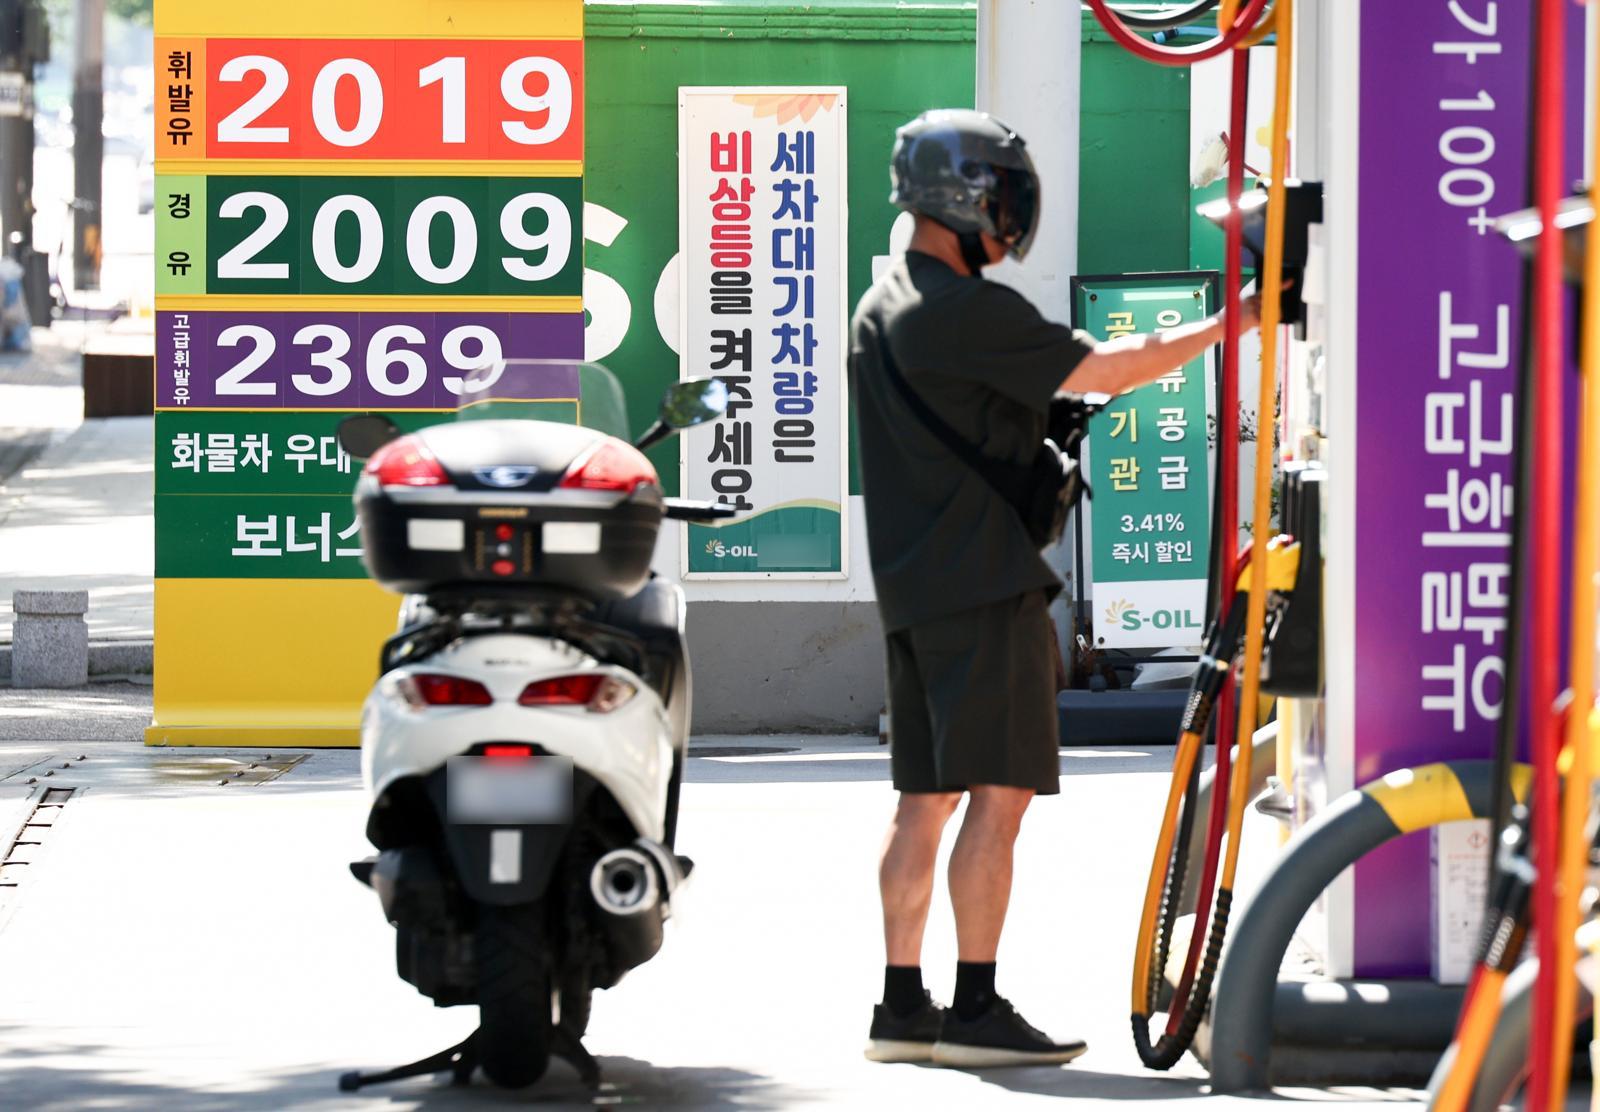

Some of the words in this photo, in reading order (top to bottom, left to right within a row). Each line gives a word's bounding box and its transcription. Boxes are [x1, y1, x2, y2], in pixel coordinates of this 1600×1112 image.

[167, 51, 193, 145] 휘발유
[217, 54, 573, 147] 2019
[1439, 90, 1496, 235] 100+
[167, 193, 192, 276] 경유
[217, 191, 573, 284] 2009
[709, 130, 755, 315] 비상등을
[770, 130, 819, 463] 세차대기차량은
[173, 314, 191, 405] 고급휘발유
[215, 324, 506, 396] 2369
[1104, 312, 1142, 491] 공기관
[171, 432, 273, 473] 화물차
[284, 433, 351, 474] 우대
[707, 328, 754, 511] 켜주세요
[714, 545, 758, 558] S-OIL
[1112, 541, 1150, 564] 즉시
[1154, 540, 1193, 563] 할인
[1120, 513, 1185, 533] 3.41%
[1422, 291, 1514, 732] 고급휘발유
[1121, 609, 1202, 631] S-OIL
